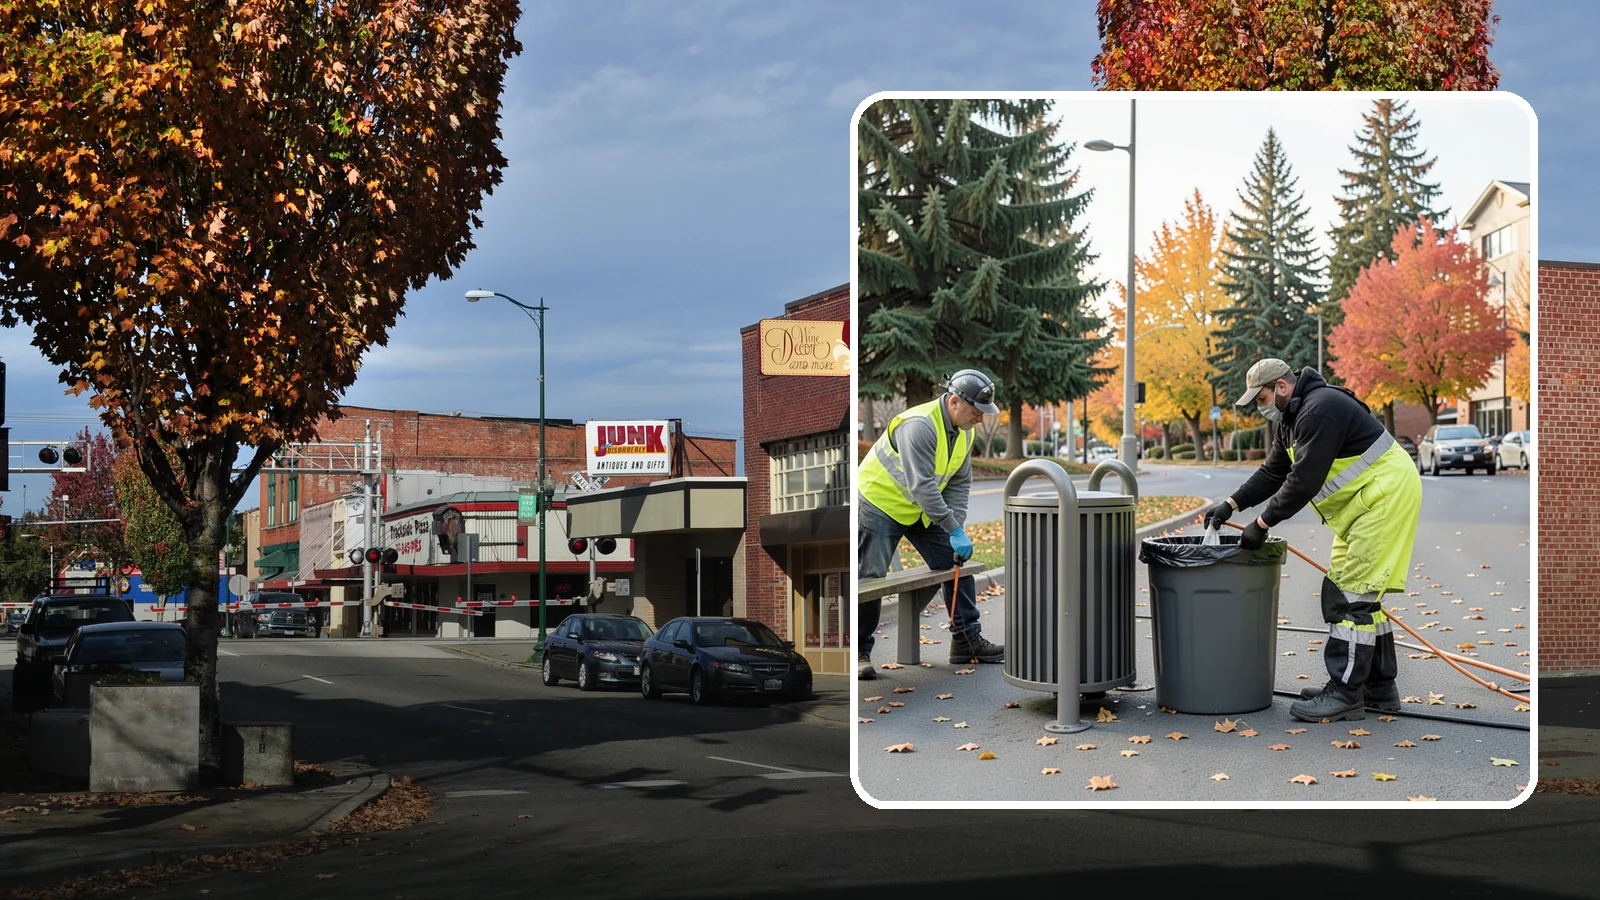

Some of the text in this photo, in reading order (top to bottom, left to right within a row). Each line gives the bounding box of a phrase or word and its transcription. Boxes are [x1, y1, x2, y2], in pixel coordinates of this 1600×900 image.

[595, 425, 665, 457] JUNK
[607, 446, 646, 454] DISORDERLY
[597, 460, 665, 470] ANTIQUES AND GIFTS
[390, 519, 429, 540] Trackside Pizza
